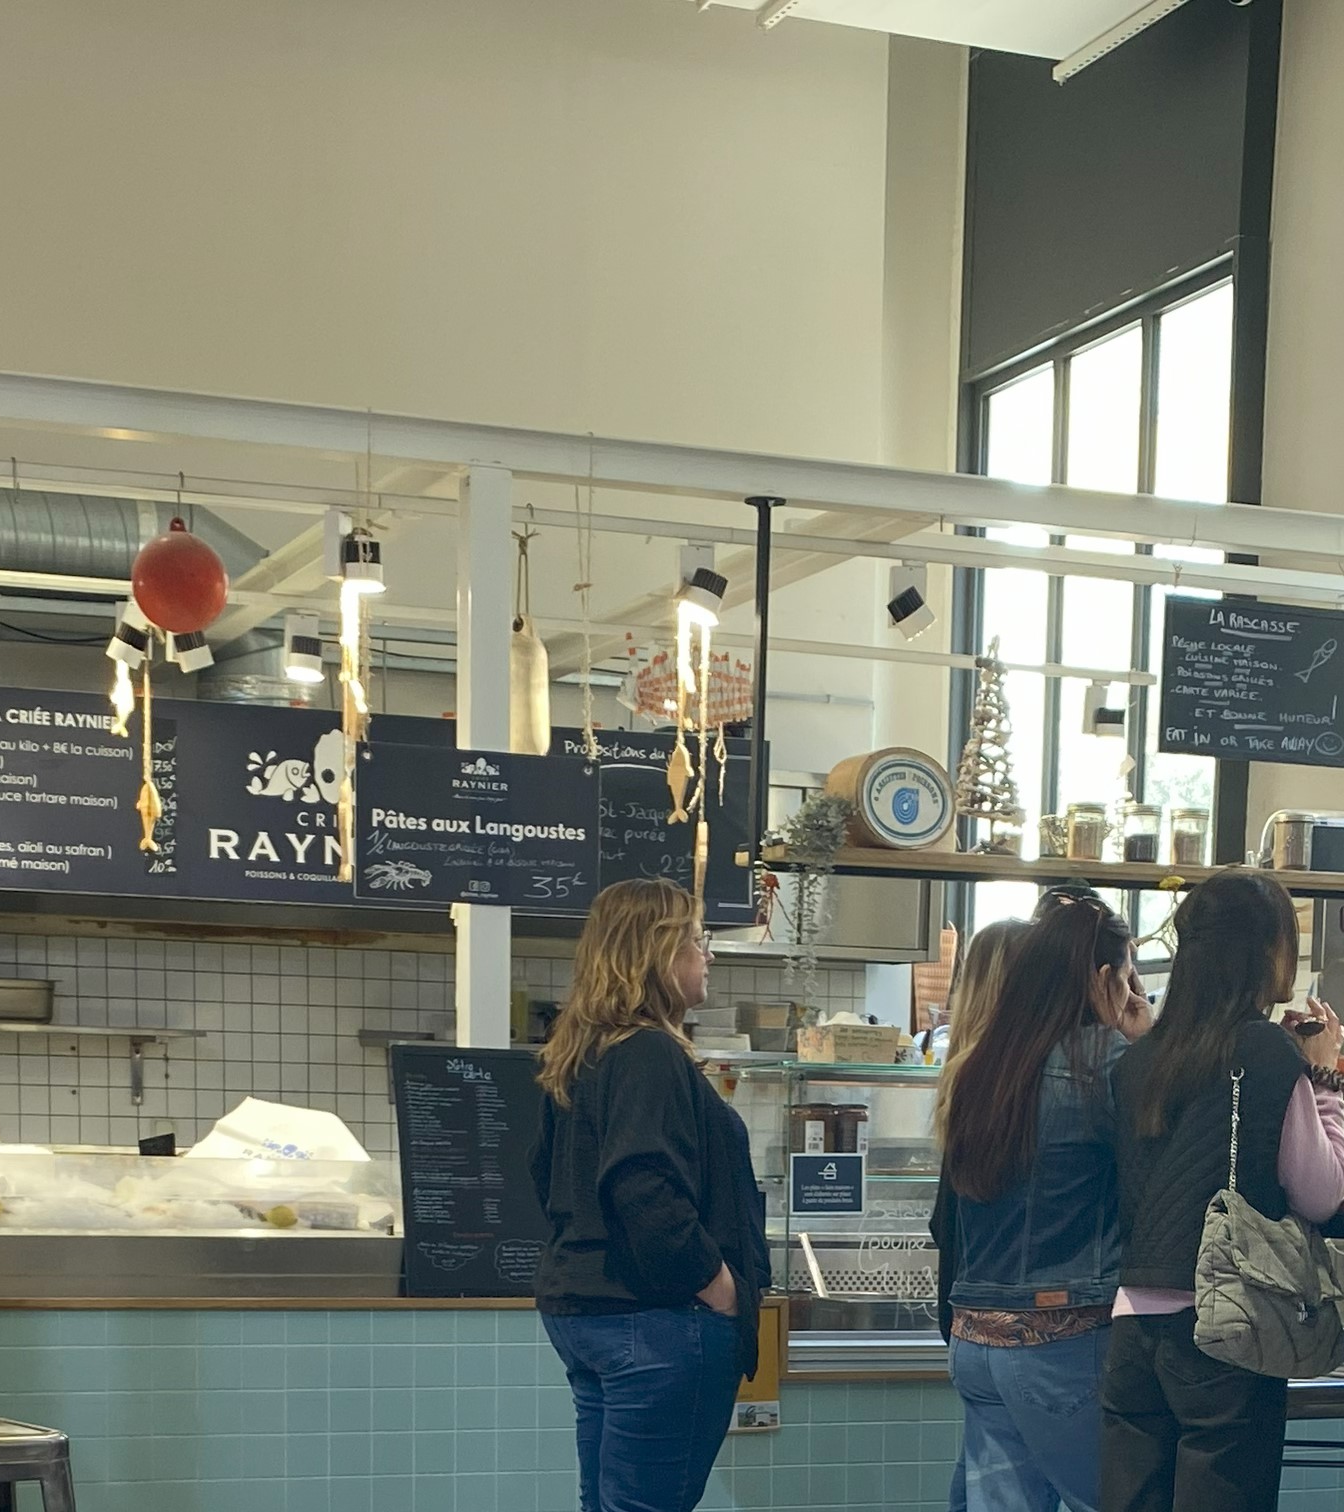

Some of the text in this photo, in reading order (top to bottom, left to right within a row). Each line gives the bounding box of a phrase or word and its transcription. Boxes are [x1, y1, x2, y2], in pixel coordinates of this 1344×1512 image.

[1210, 609, 1225, 626] LA
[1211, 642, 1255, 653] LOCALE
[6, 706, 51, 726] CRIÉE
[1220, 710, 1266, 721] BONNE
[1166, 727, 1187, 741] EAT
[1221, 736, 1238, 747] OR
[1245, 736, 1275, 750] TAKE
[1281, 736, 1316, 755] AWAY
[0, 740, 16, 751] au
[19, 740, 40, 752] kilo
[53, 743, 68, 754] 8€
[71, 743, 82, 755] la
[85, 745, 133, 760] cuisson)
[649, 745, 666, 759] du
[452, 779, 508, 791] RAYNIER
[25, 790, 67, 804] tartare
[70, 794, 118, 809] maison)
[296, 812, 337, 827] CRI
[372, 808, 427, 831] Pâtes
[431, 817, 471, 834] aux
[475, 815, 586, 843] Langoustes
[18, 842, 43, 854] aïoli
[46, 845, 62, 854] au
[65, 845, 104, 856] safran
[208, 828, 343, 865] RAYN
[21, 859, 70, 874] maison)
[245, 870, 287, 880] POISSONS
[297, 873, 337, 882] COQUILLA
